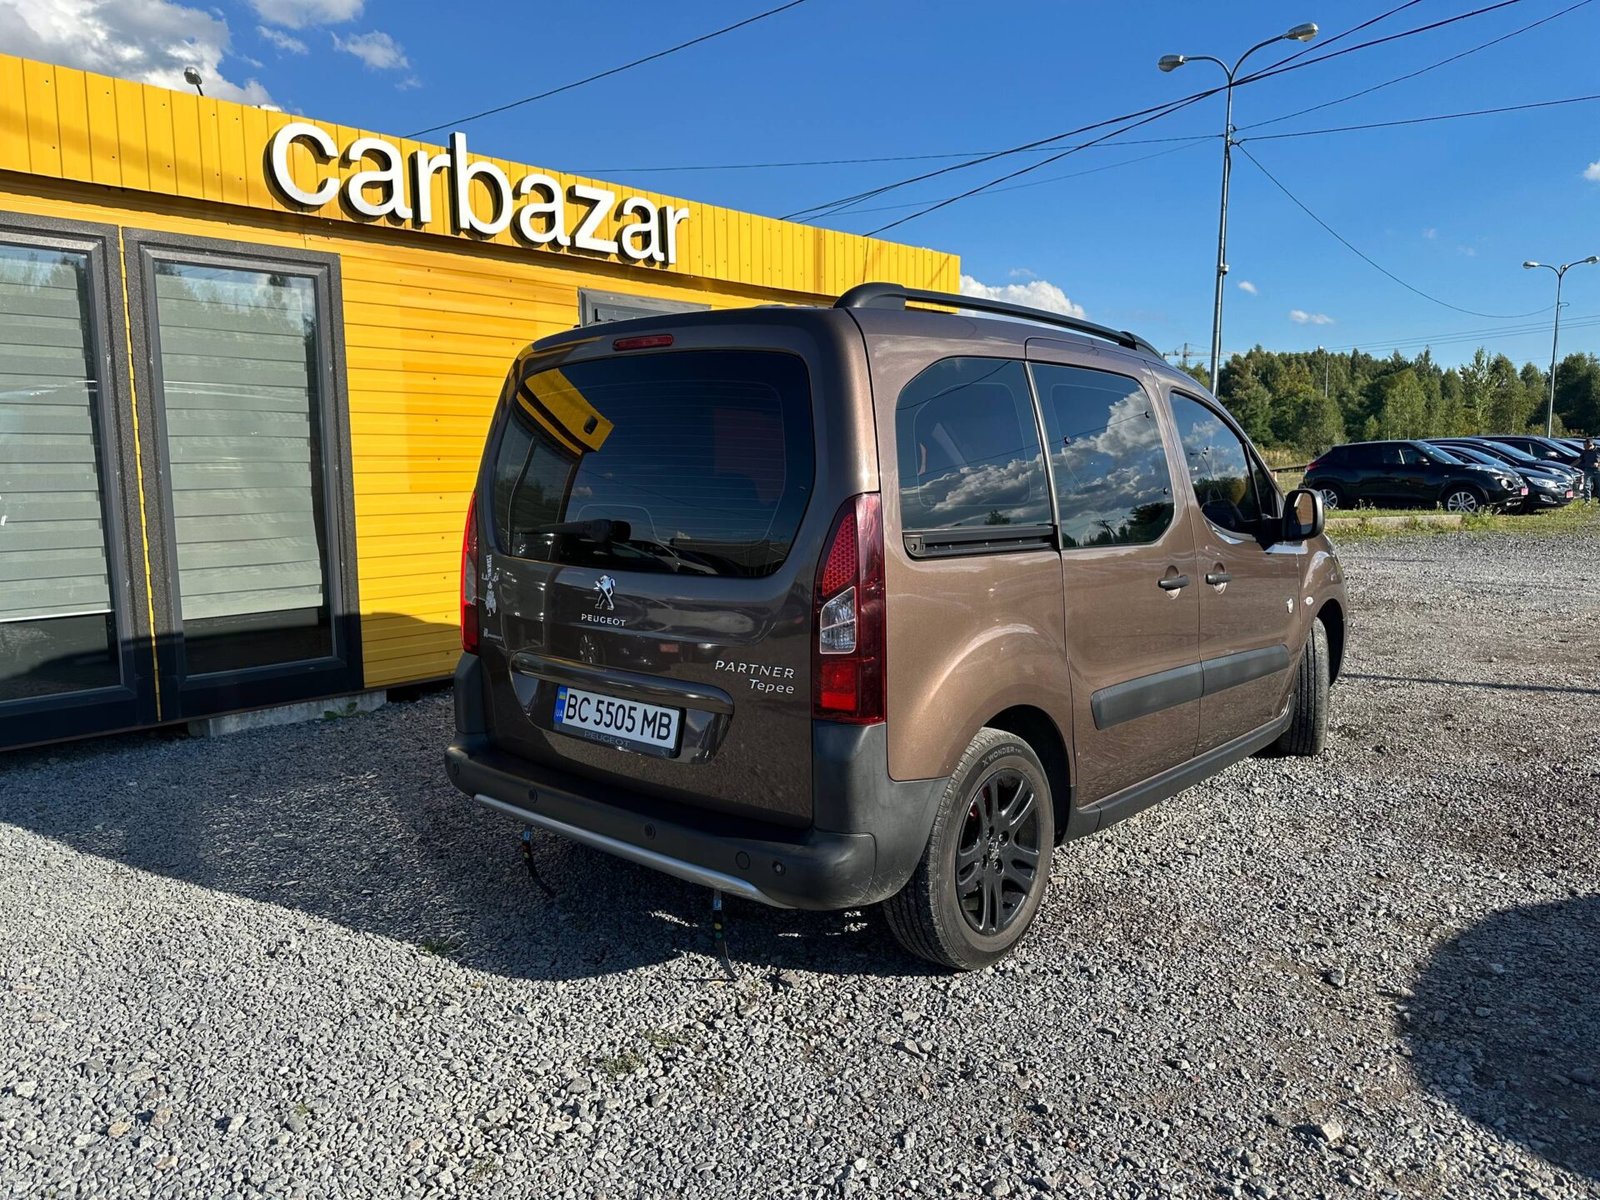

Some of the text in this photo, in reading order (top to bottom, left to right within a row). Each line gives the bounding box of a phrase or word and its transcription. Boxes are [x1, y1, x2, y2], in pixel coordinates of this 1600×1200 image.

[266, 121, 690, 267] carbazar
[581, 613, 627, 627] PEUGEOT
[714, 660, 795, 679] PARTNER
[749, 678, 795, 694] Tepee
[555, 709, 563, 718] UA
[565, 693, 672, 741] BC 5505 MB
[584, 730, 632, 747] PEUGEOT
